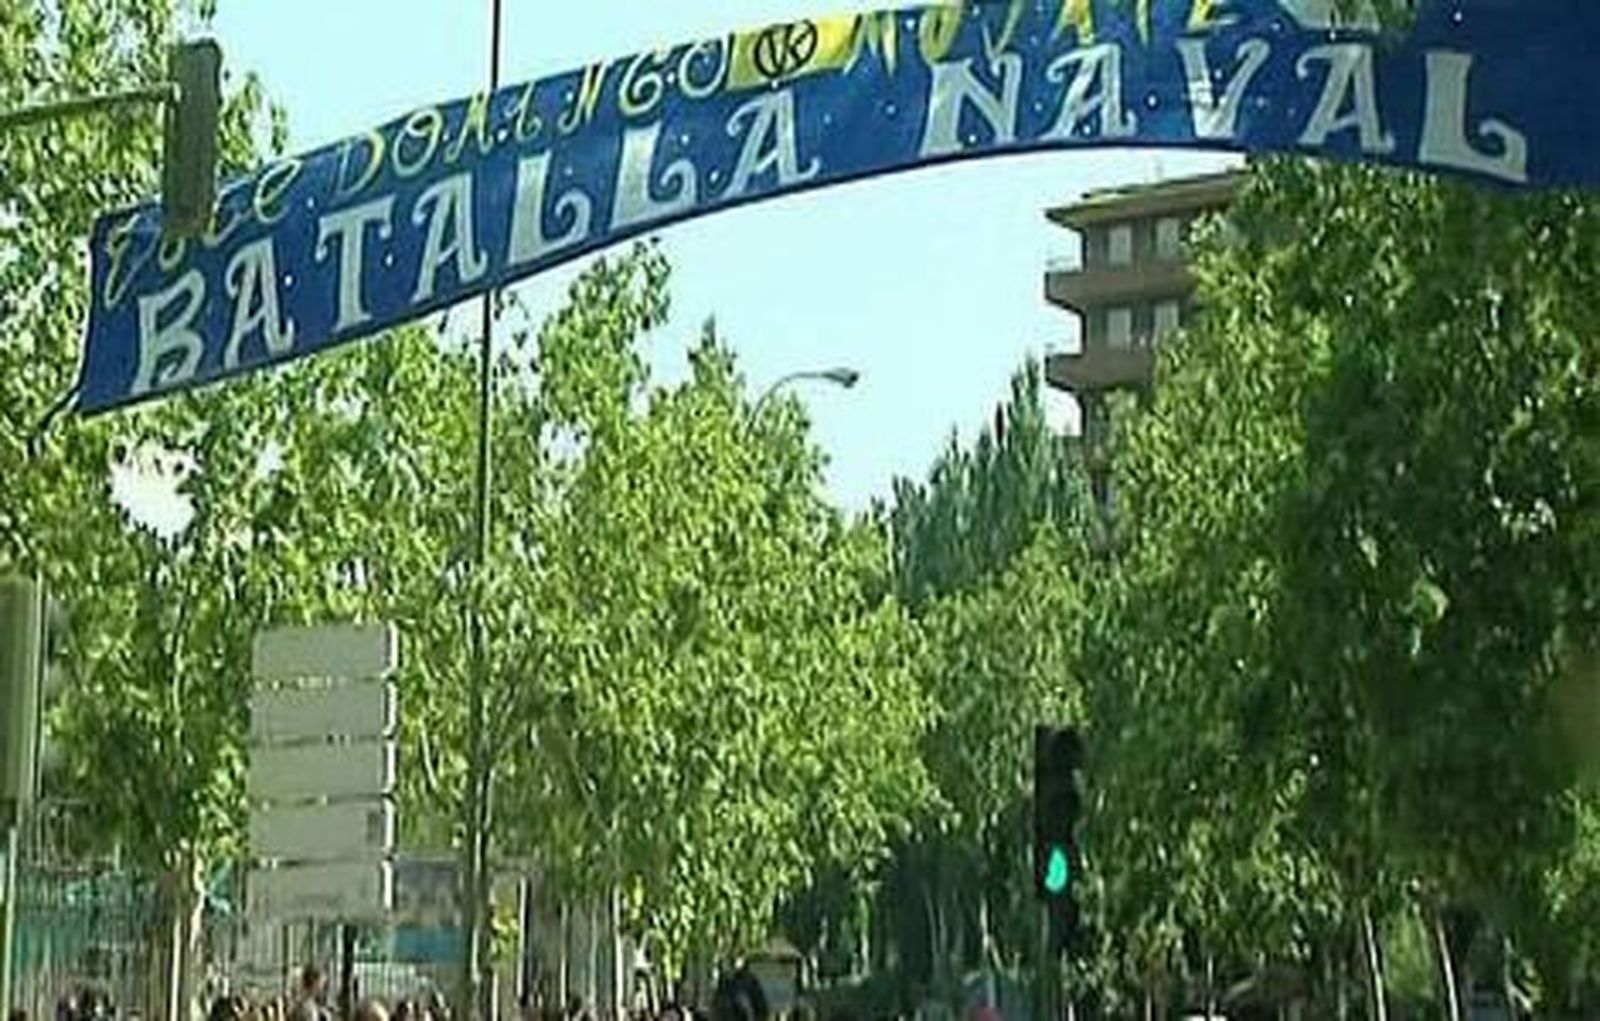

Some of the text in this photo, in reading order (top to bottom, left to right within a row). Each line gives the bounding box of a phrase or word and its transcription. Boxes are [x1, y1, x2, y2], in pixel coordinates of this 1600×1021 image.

[130, 38, 1527, 394] BATALLA NAVAL
[333, 36, 731, 196] DOMINGO
